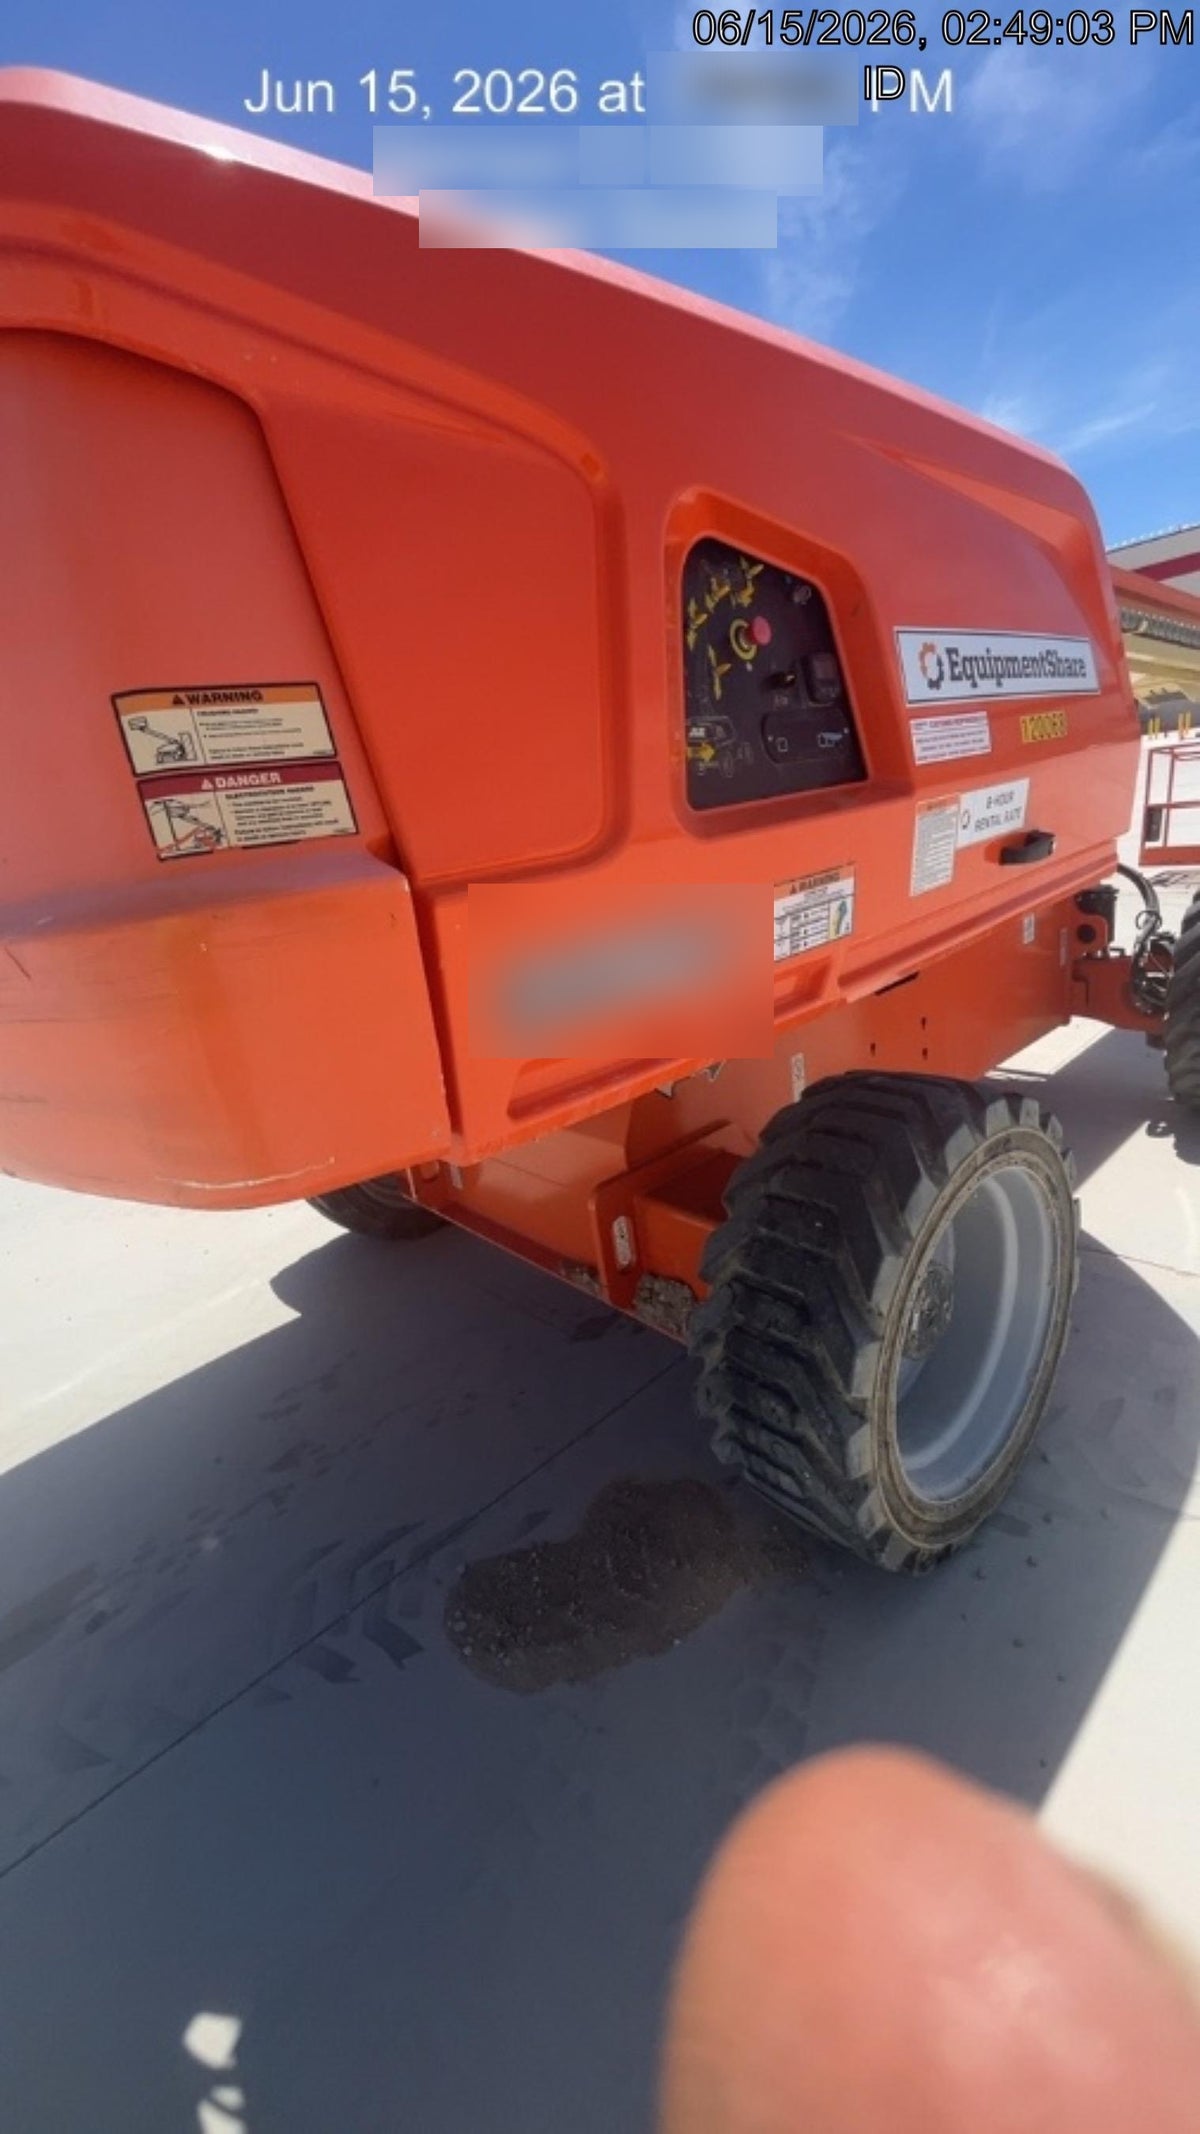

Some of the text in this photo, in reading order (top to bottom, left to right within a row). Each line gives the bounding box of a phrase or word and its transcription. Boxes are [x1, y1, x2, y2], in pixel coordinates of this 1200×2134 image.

[945, 646, 1087, 688] EquipmentShare
[187, 689, 264, 706] WARNING
[215, 772, 281, 788] DANGER
